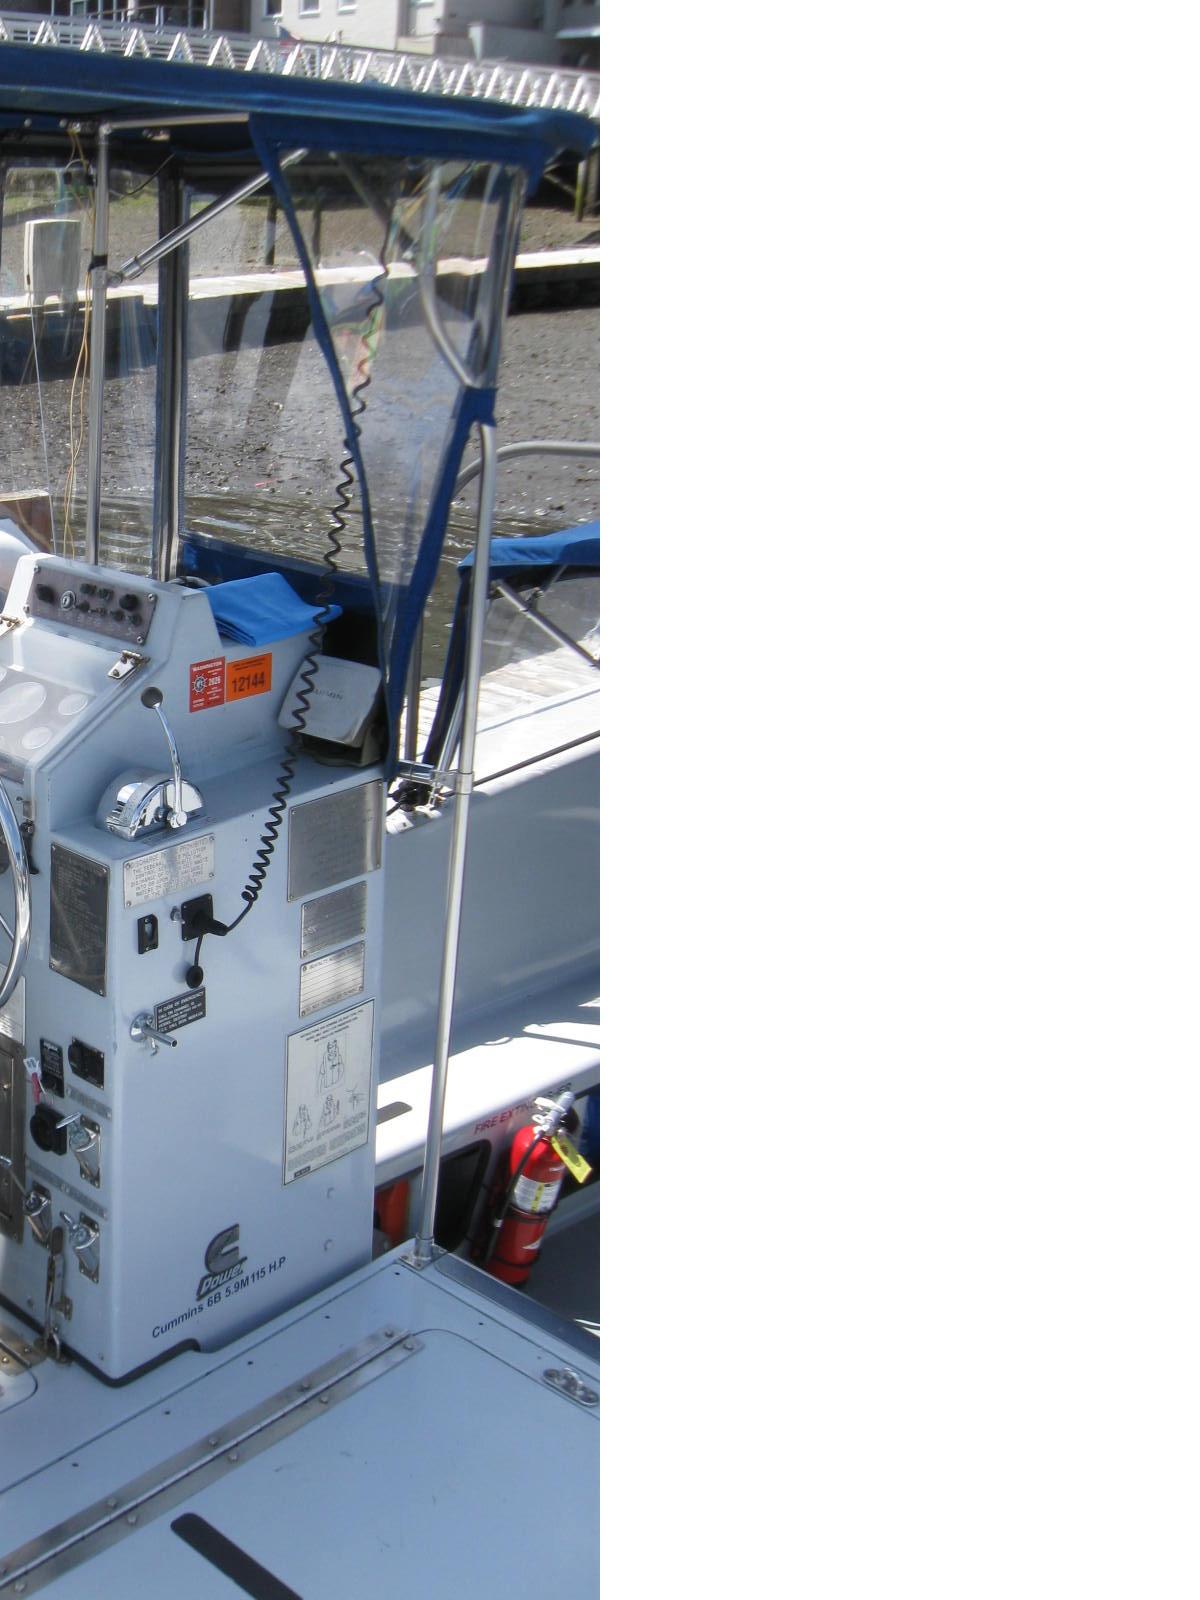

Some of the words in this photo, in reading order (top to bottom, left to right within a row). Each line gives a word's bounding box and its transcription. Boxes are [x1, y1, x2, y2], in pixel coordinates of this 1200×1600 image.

[231, 671, 265, 693] 12144
[474, 1115, 497, 1135] FIRE
[152, 1303, 203, 1338] Cummins
[207, 1292, 222, 1307] 6B
